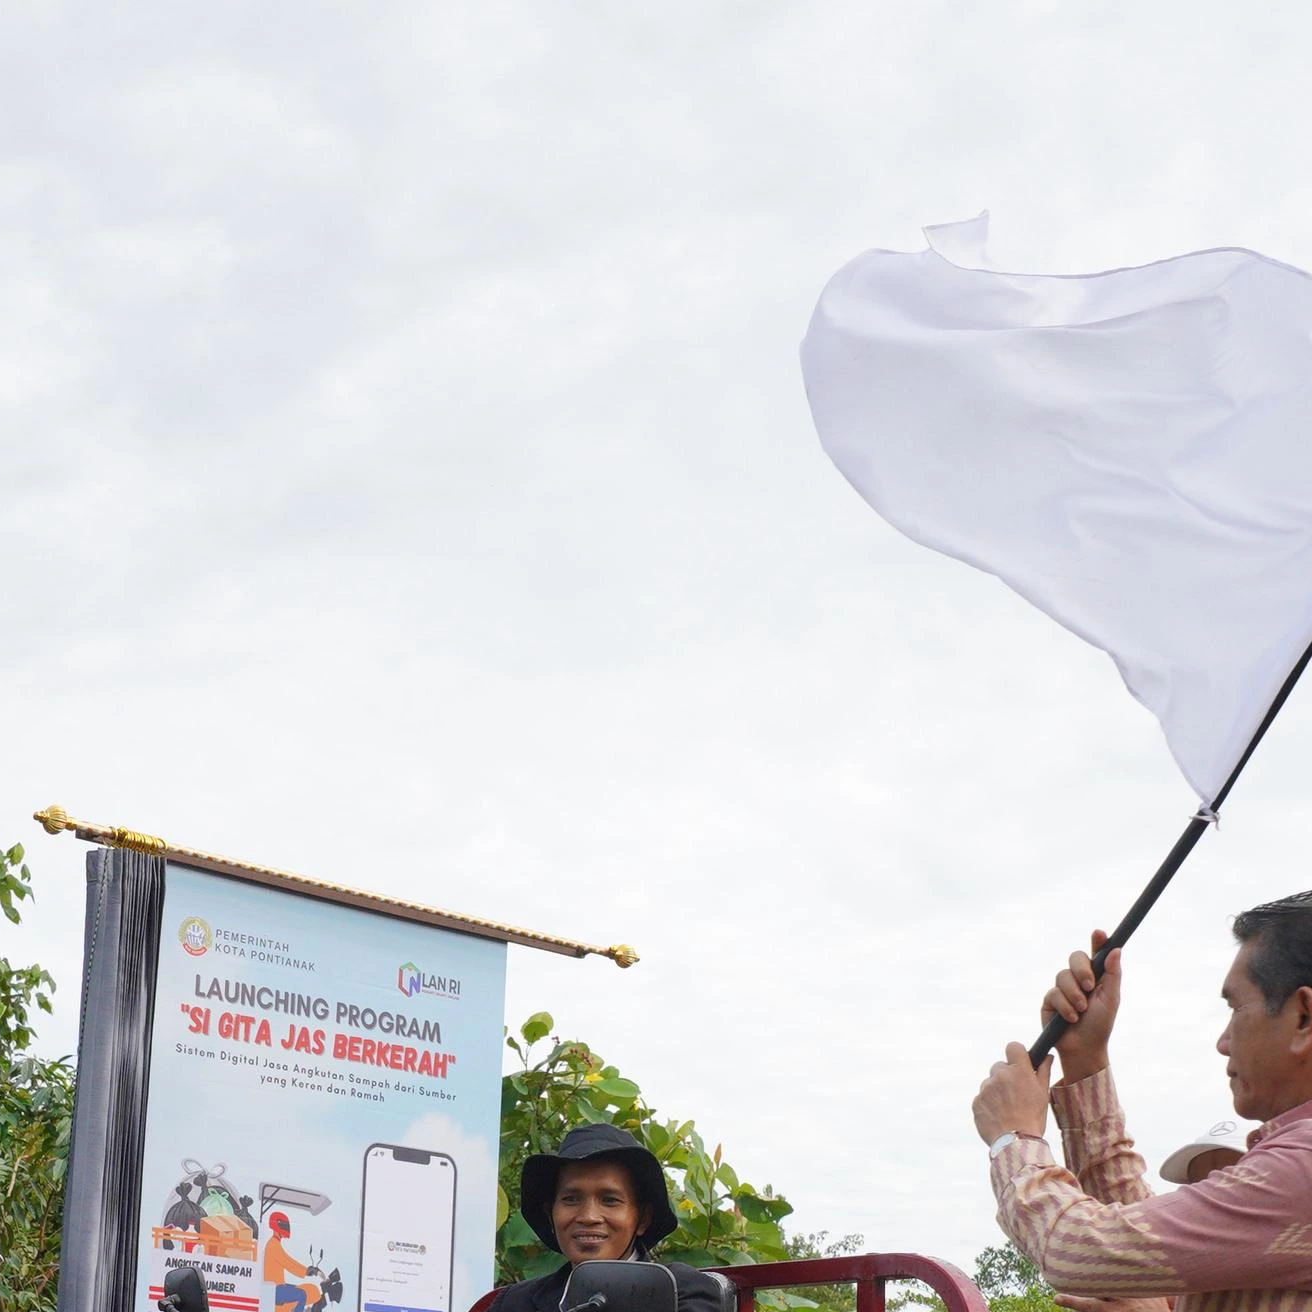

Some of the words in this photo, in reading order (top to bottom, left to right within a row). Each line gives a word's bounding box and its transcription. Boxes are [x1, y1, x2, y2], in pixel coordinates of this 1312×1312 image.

[215, 928, 290, 953] PEMERINTAH
[214, 943, 246, 958] KOTA
[250, 950, 316, 972] PONTIANAK
[422, 972, 446, 992] LAN
[448, 978, 461, 995] RI
[194, 973, 330, 1021] LAUNCHING
[335, 1001, 442, 1044] PROGRAM
[180, 1003, 211, 1036] "SI
[218, 1011, 273, 1047] GITA
[280, 1023, 326, 1056] JAS
[332, 1033, 457, 1079] BERKERAH"
[175, 1043, 215, 1059] Sistem
[220, 1050, 259, 1066] Digital
[263, 1058, 289, 1072] Jasa
[293, 1063, 345, 1081] Angkutan
[348, 1073, 391, 1089] Sampah
[394, 1081, 415, 1094] dari
[418, 1086, 457, 1101] Sumber
[260, 1074, 287, 1089] yang
[291, 1077, 323, 1092] Keren
[326, 1082, 346, 1096] dan
[350, 1088, 385, 1103] Ramah
[215, 1263, 253, 1278] SAMPAH
[204, 1280, 236, 1294] UMBER
